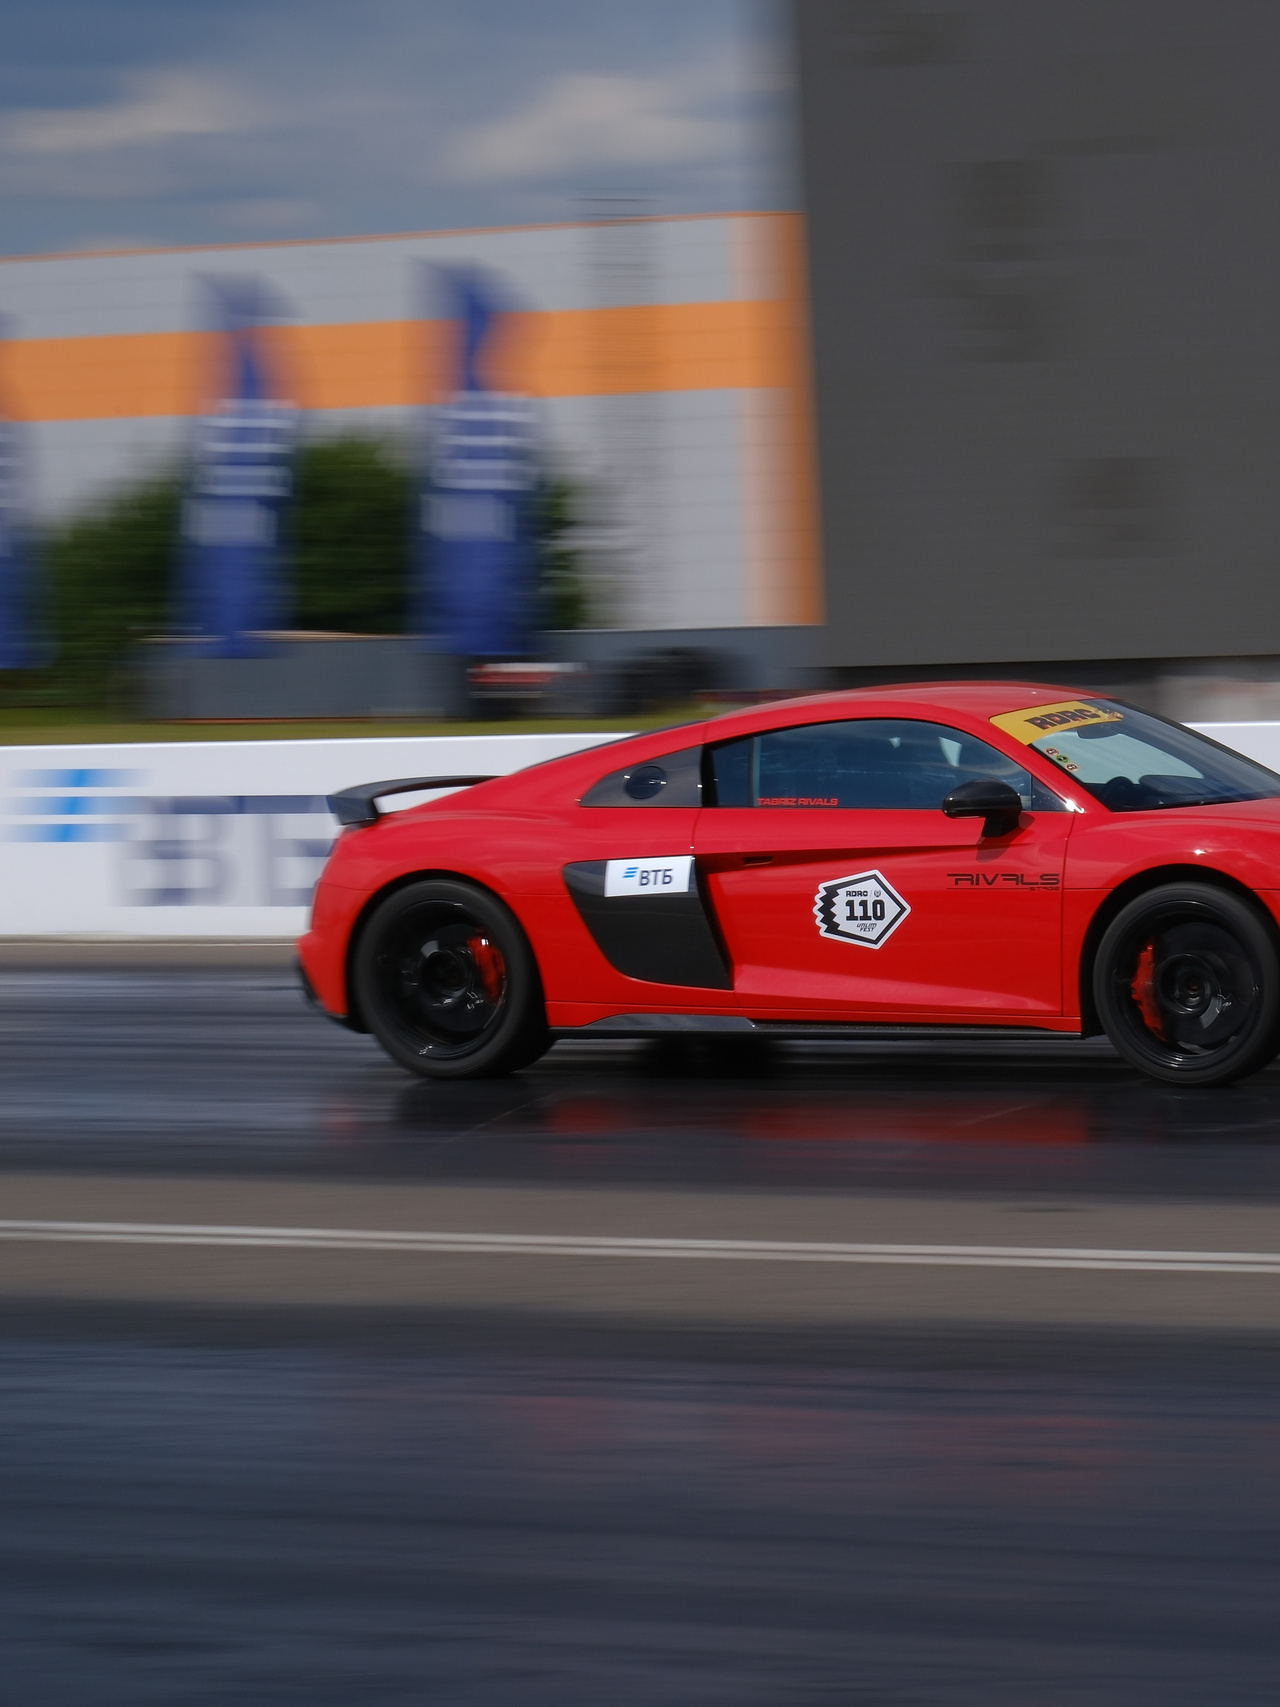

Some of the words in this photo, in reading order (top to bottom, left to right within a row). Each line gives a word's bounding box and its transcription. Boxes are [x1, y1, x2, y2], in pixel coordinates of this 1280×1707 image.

[1024, 708, 1101, 730] RDRC
[757, 797, 797, 806] TABRIZ
[798, 797, 839, 806] RIVALS
[639, 868, 673, 886] ВТБ
[947, 873, 1060, 886] RIVALS
[845, 899, 886, 921] 110
